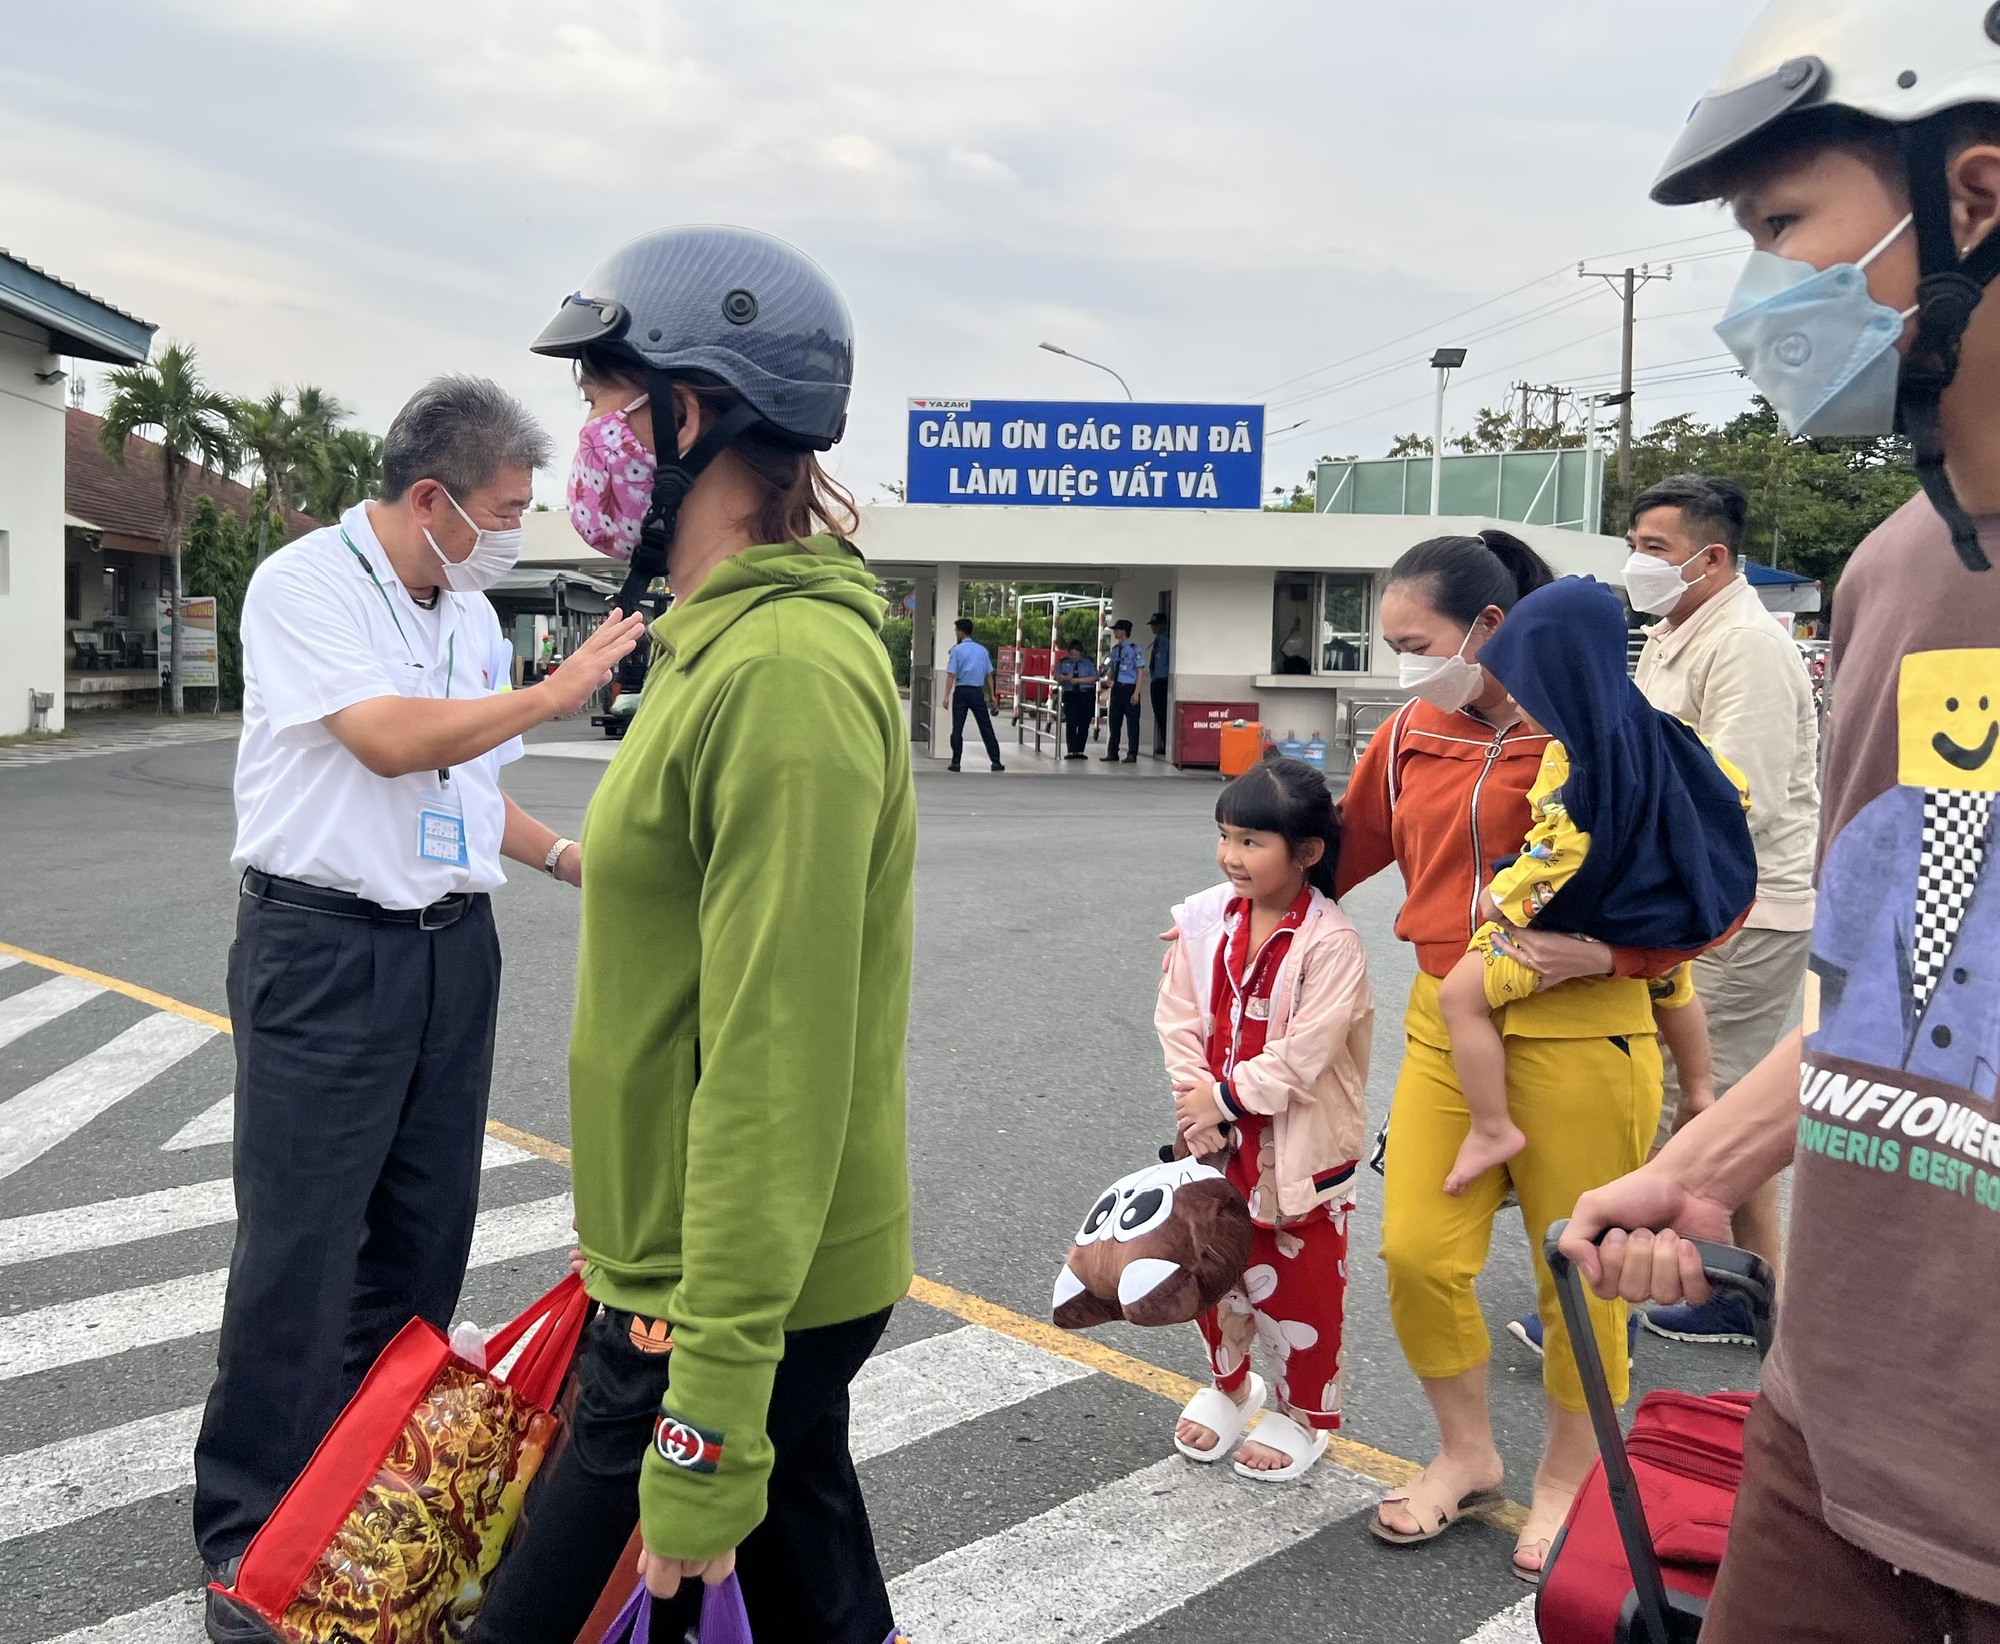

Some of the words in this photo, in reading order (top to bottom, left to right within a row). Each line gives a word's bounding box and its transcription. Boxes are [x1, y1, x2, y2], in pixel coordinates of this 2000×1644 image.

[918, 412, 991, 449] CẢM
[1001, 419, 1046, 450] ƠN
[1056, 417, 1121, 451] CÁC
[1131, 424, 1198, 457] BẠN
[1208, 420, 1252, 453] ĐÃ
[948, 462, 1017, 495] LÀM
[1027, 464, 1098, 502] VIỆC
[1108, 462, 1169, 498] VẤT
[1177, 463, 1218, 499] VẢ
[1908, 1146, 1973, 1197] BEST
